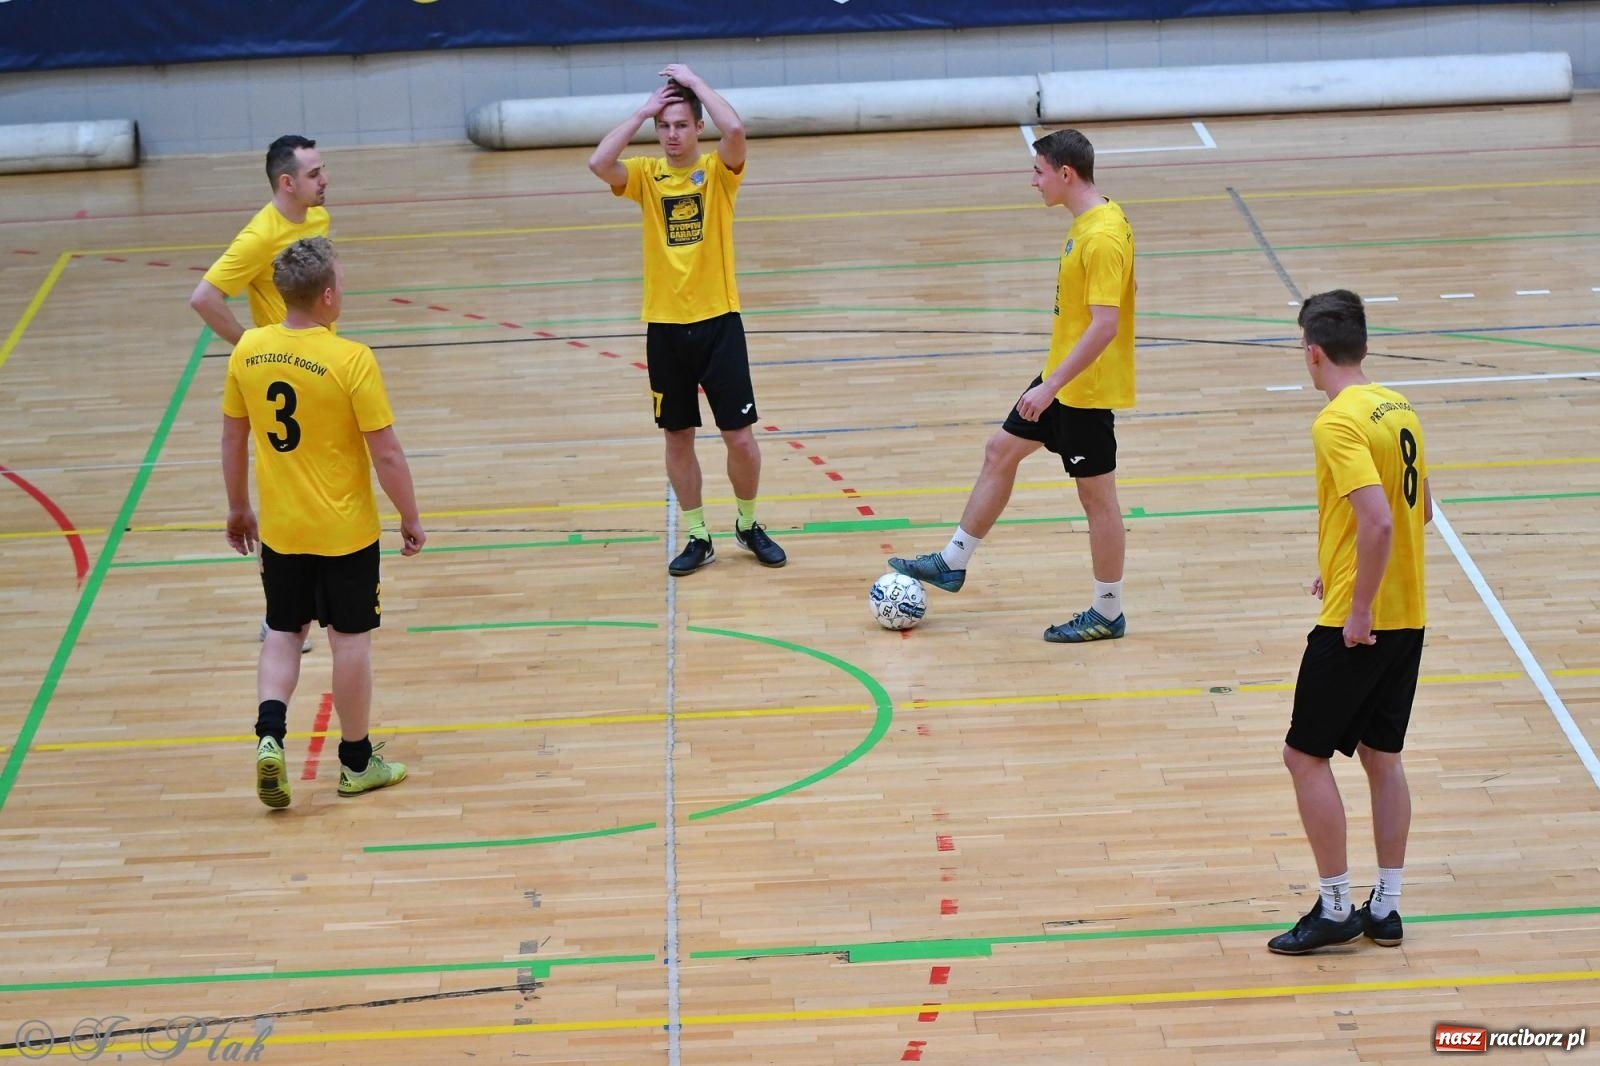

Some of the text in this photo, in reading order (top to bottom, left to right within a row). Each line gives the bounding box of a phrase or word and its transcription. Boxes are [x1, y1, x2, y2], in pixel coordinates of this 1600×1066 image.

[245, 352, 328, 377] PRZYSZŁOŚĆ ROGÓW
[266, 381, 301, 453] 3
[1400, 427, 1418, 509] 8
